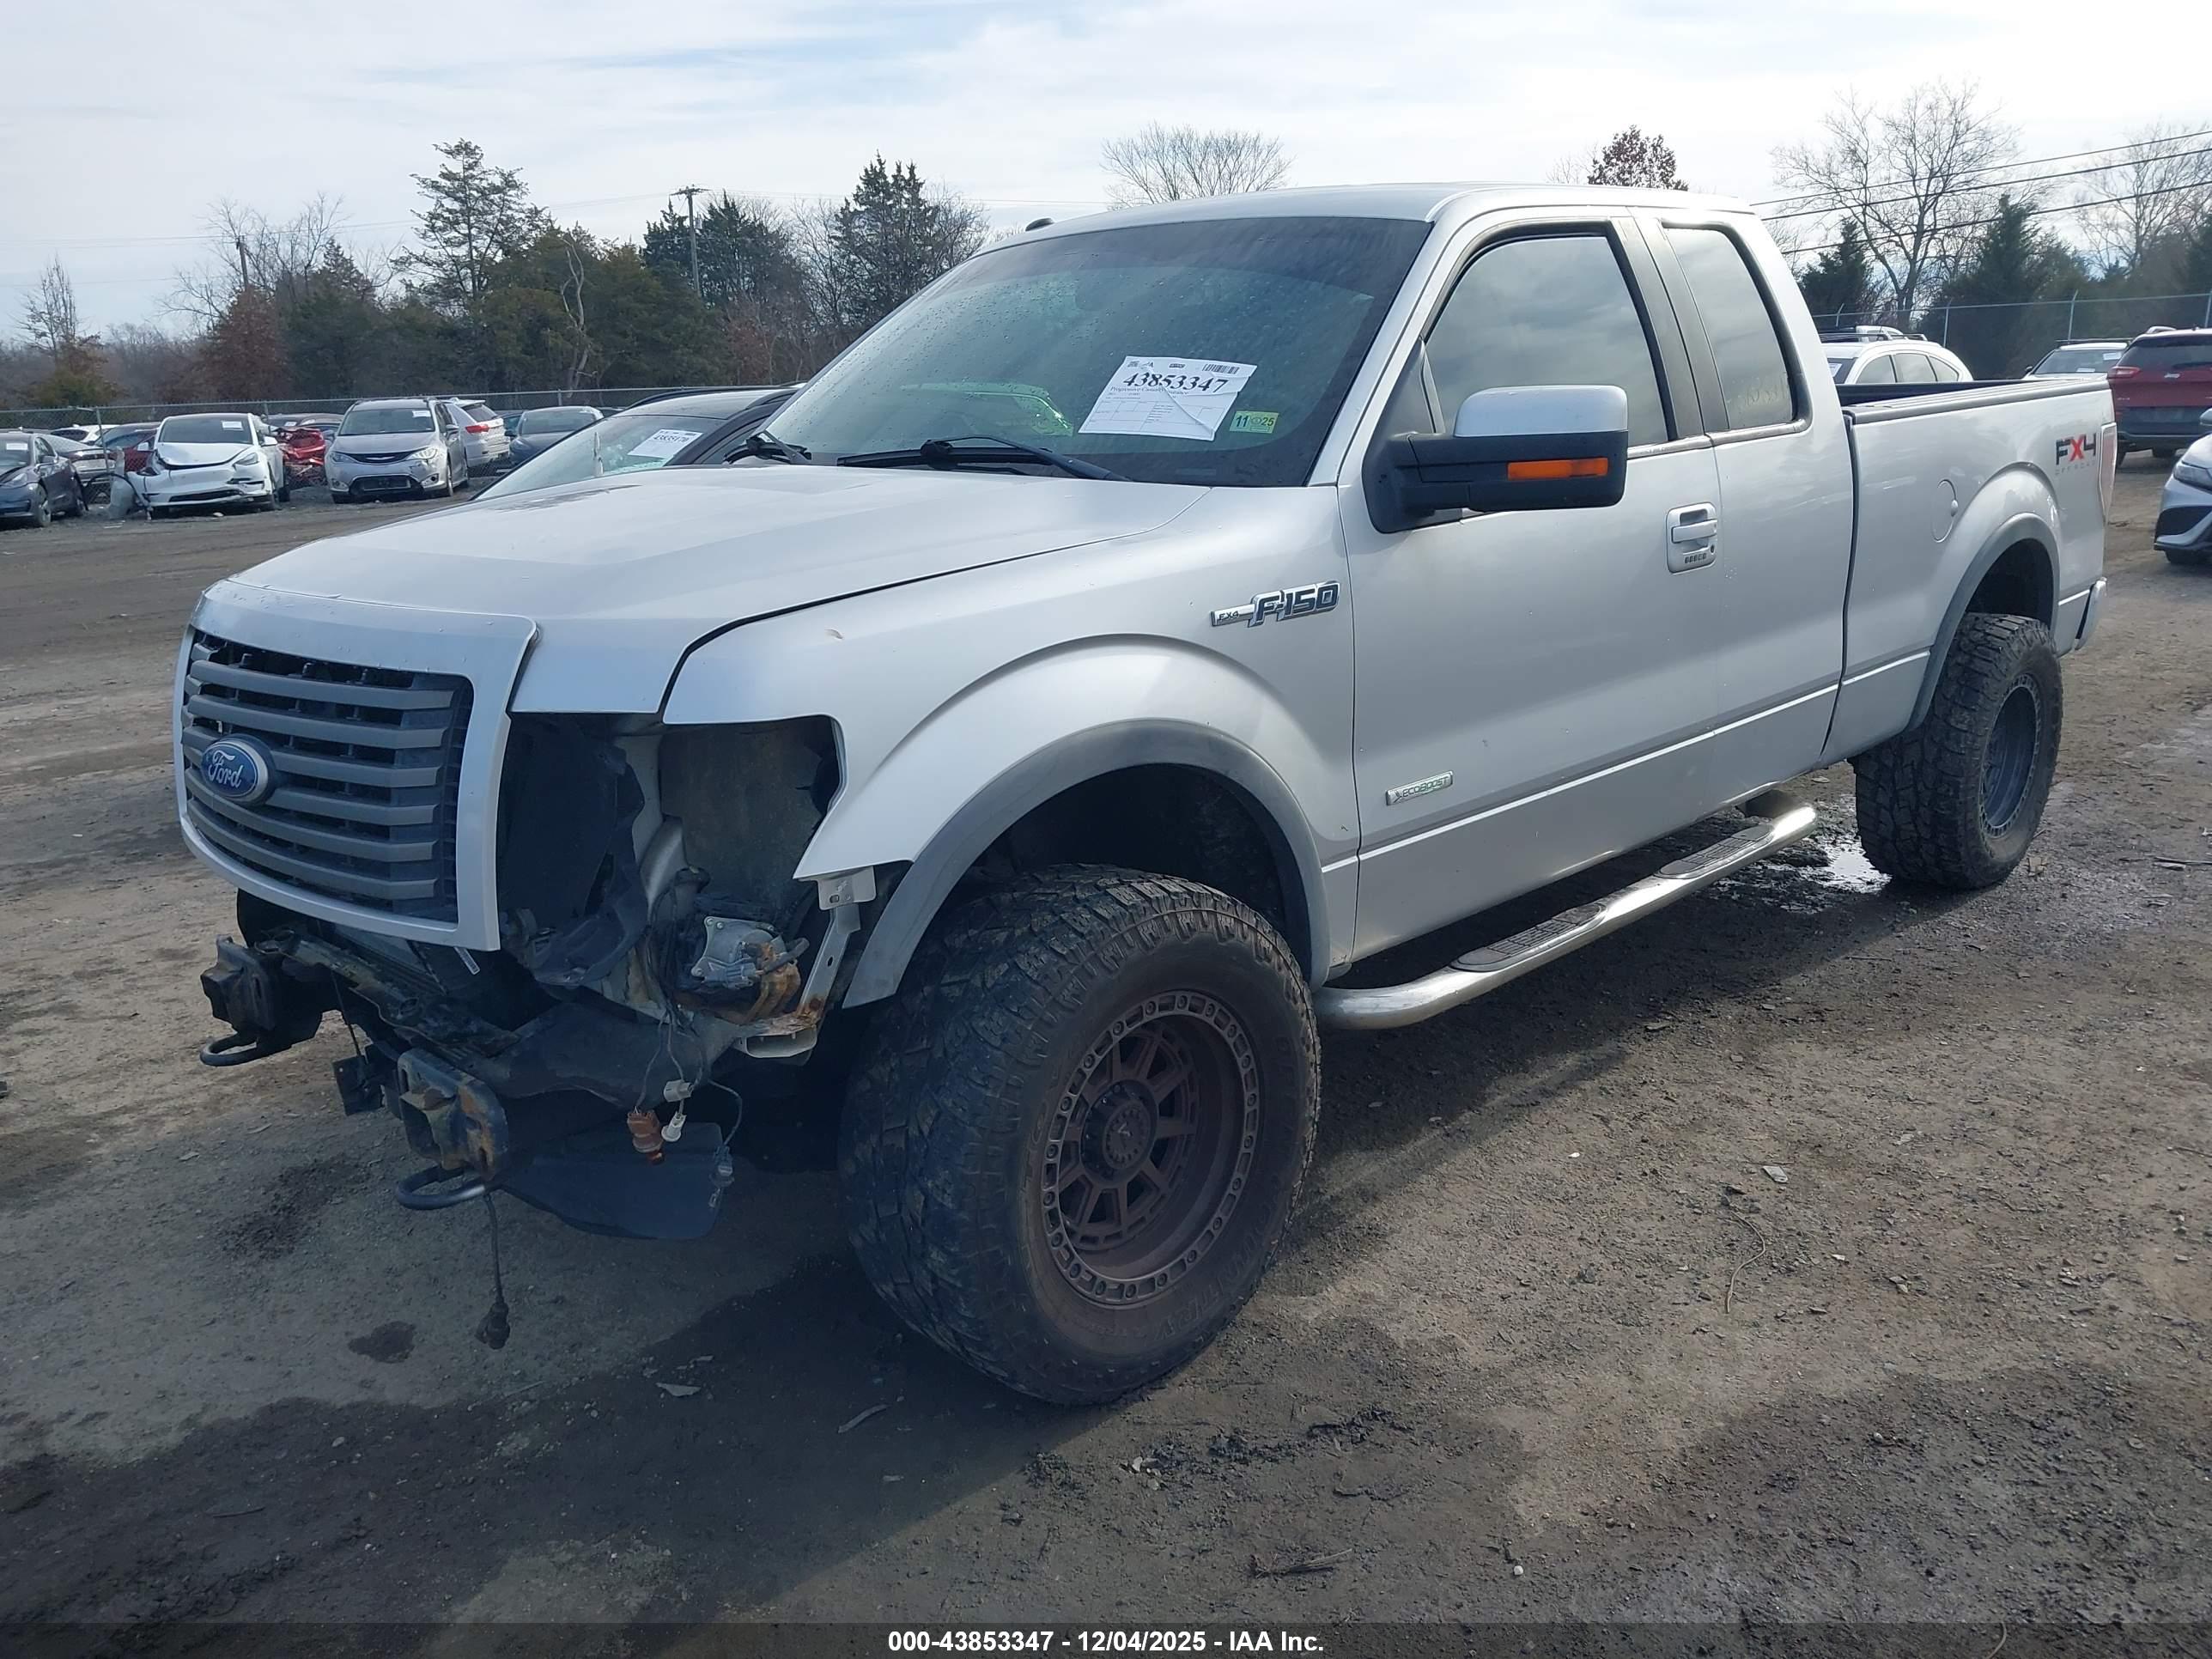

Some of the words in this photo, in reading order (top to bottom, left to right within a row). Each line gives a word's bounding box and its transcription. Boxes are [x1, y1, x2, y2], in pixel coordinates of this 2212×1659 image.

[1123, 372, 1229, 393] 43853347
[1236, 416, 1249, 428] 11
[1261, 416, 1275, 427] 25
[2055, 432, 2097, 465] FX4
[1218, 610, 1240, 621] FX4
[207, 749, 245, 789] Ford
